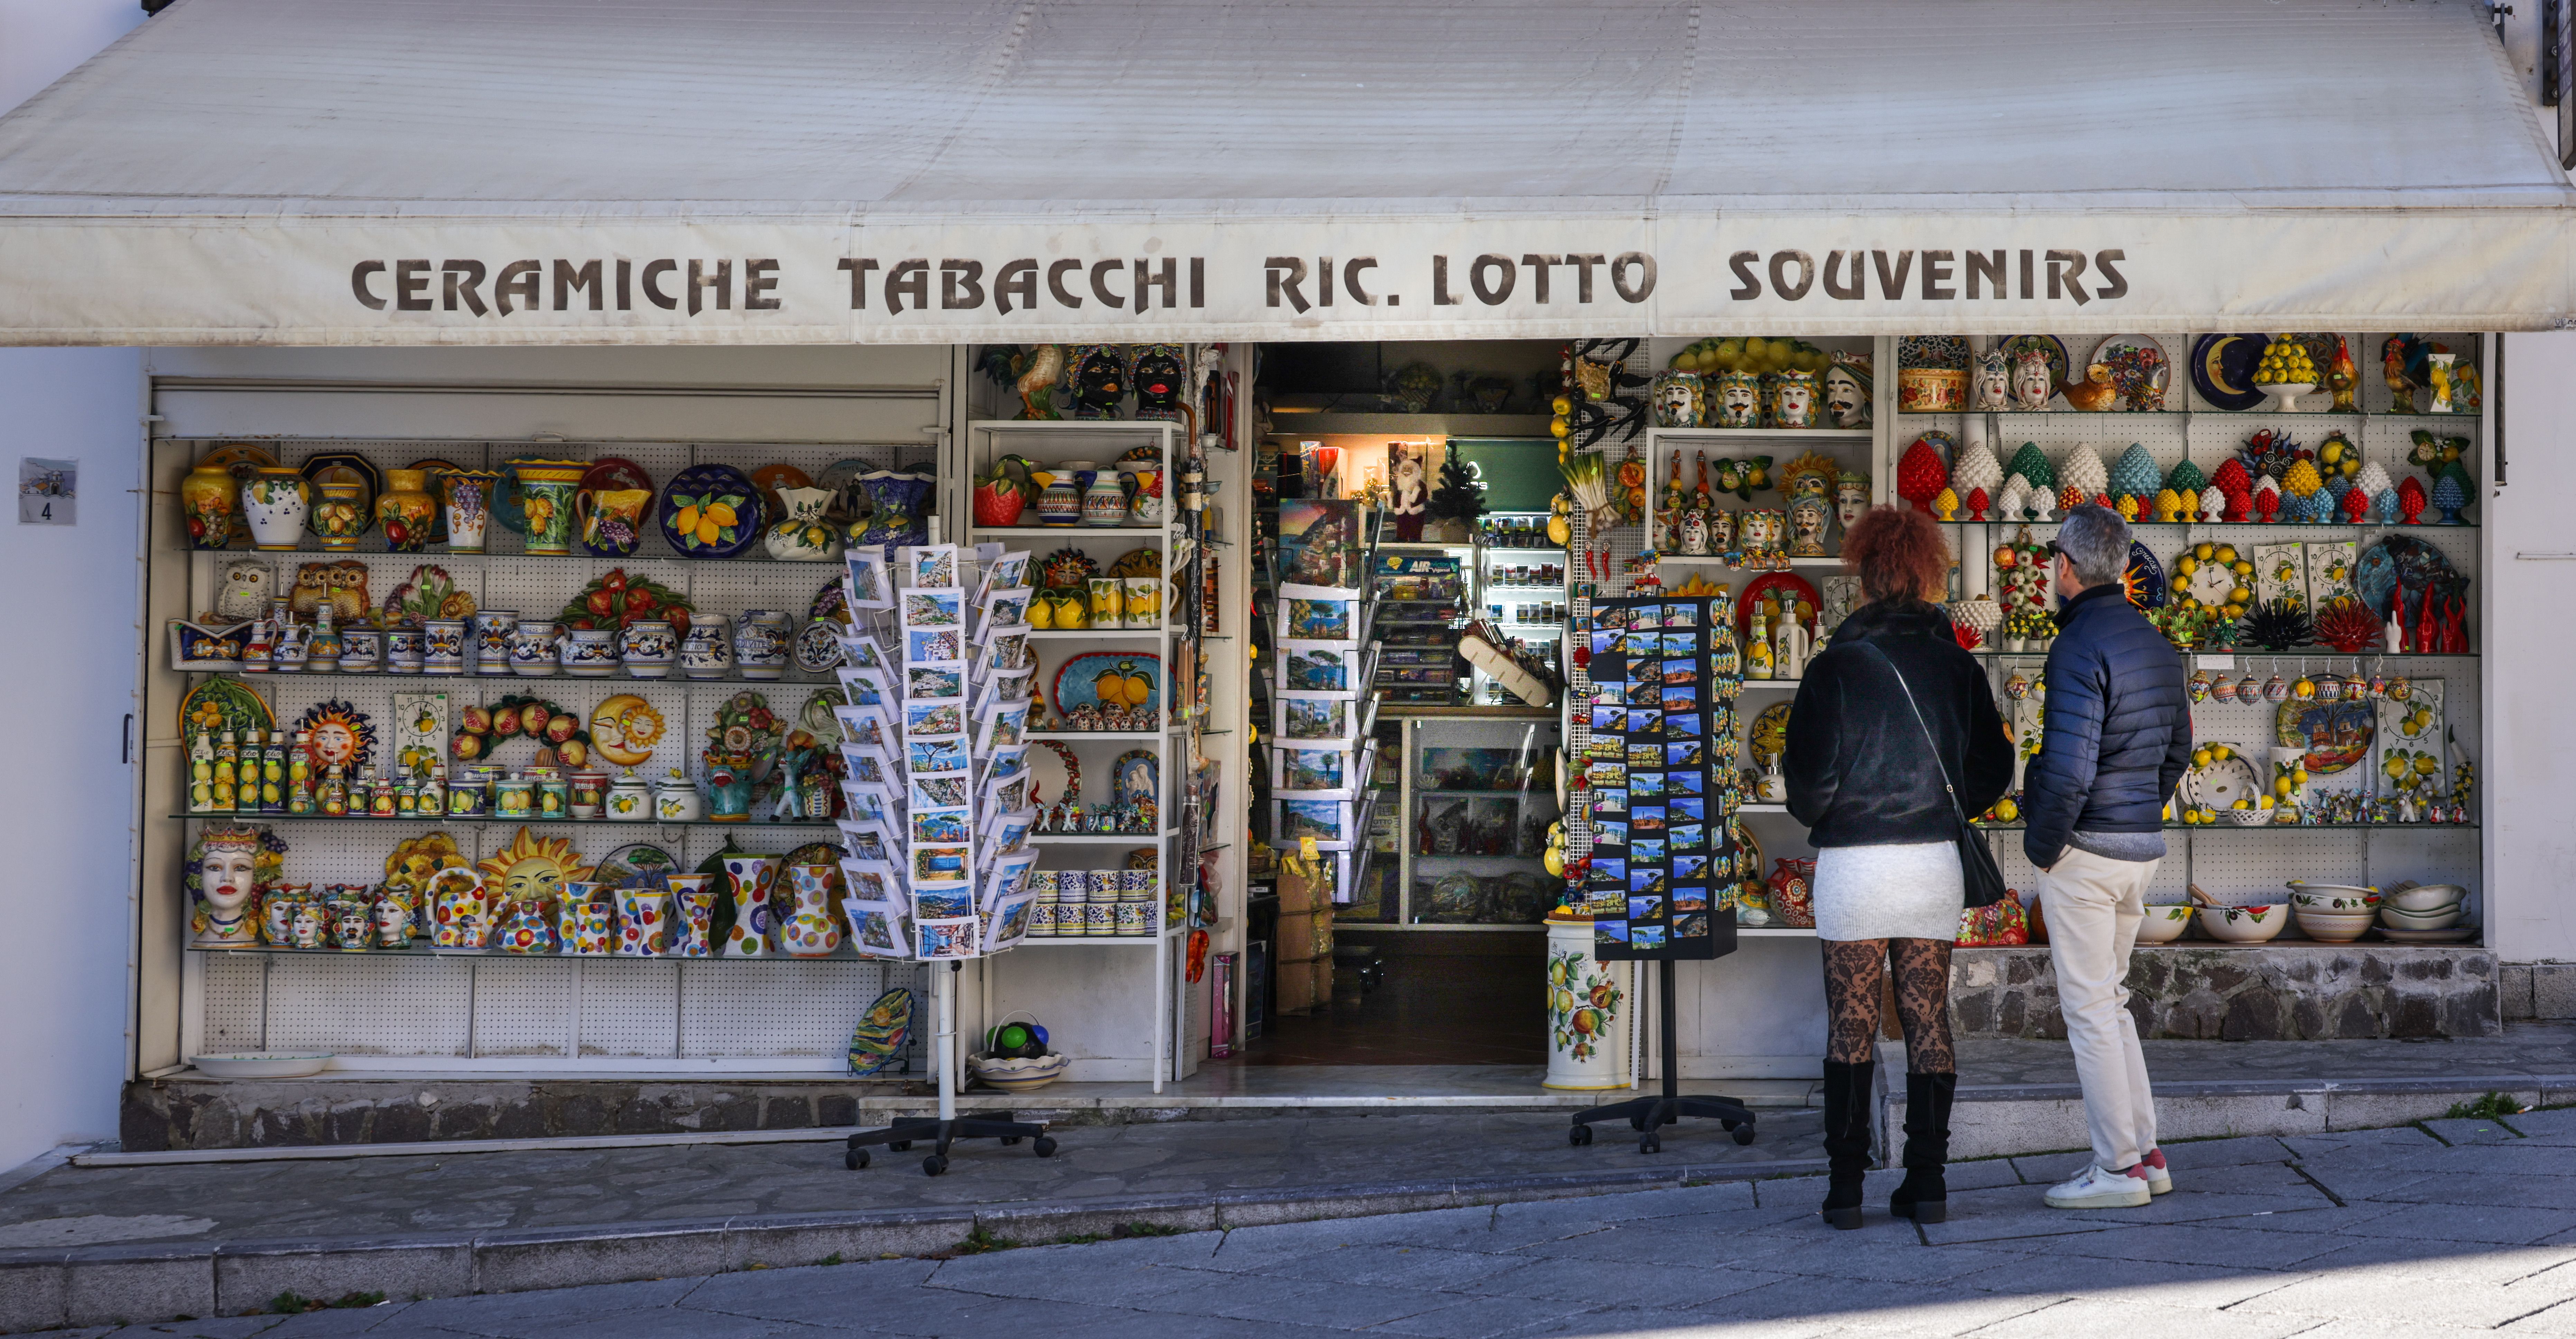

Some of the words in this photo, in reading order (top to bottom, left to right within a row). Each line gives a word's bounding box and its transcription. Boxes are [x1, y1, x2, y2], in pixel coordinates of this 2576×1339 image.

[351, 257, 782, 318] CERAMICHE
[838, 256, 1207, 316] TABACCHI
[1264, 255, 1400, 313] RIC.
[1431, 251, 1658, 306] LOTTO
[1729, 249, 2128, 306] SOUVENIRS
[41, 502, 52, 520] 4
[1409, 561, 1431, 572] AIR
[2132, 547, 2157, 575] Grecale
